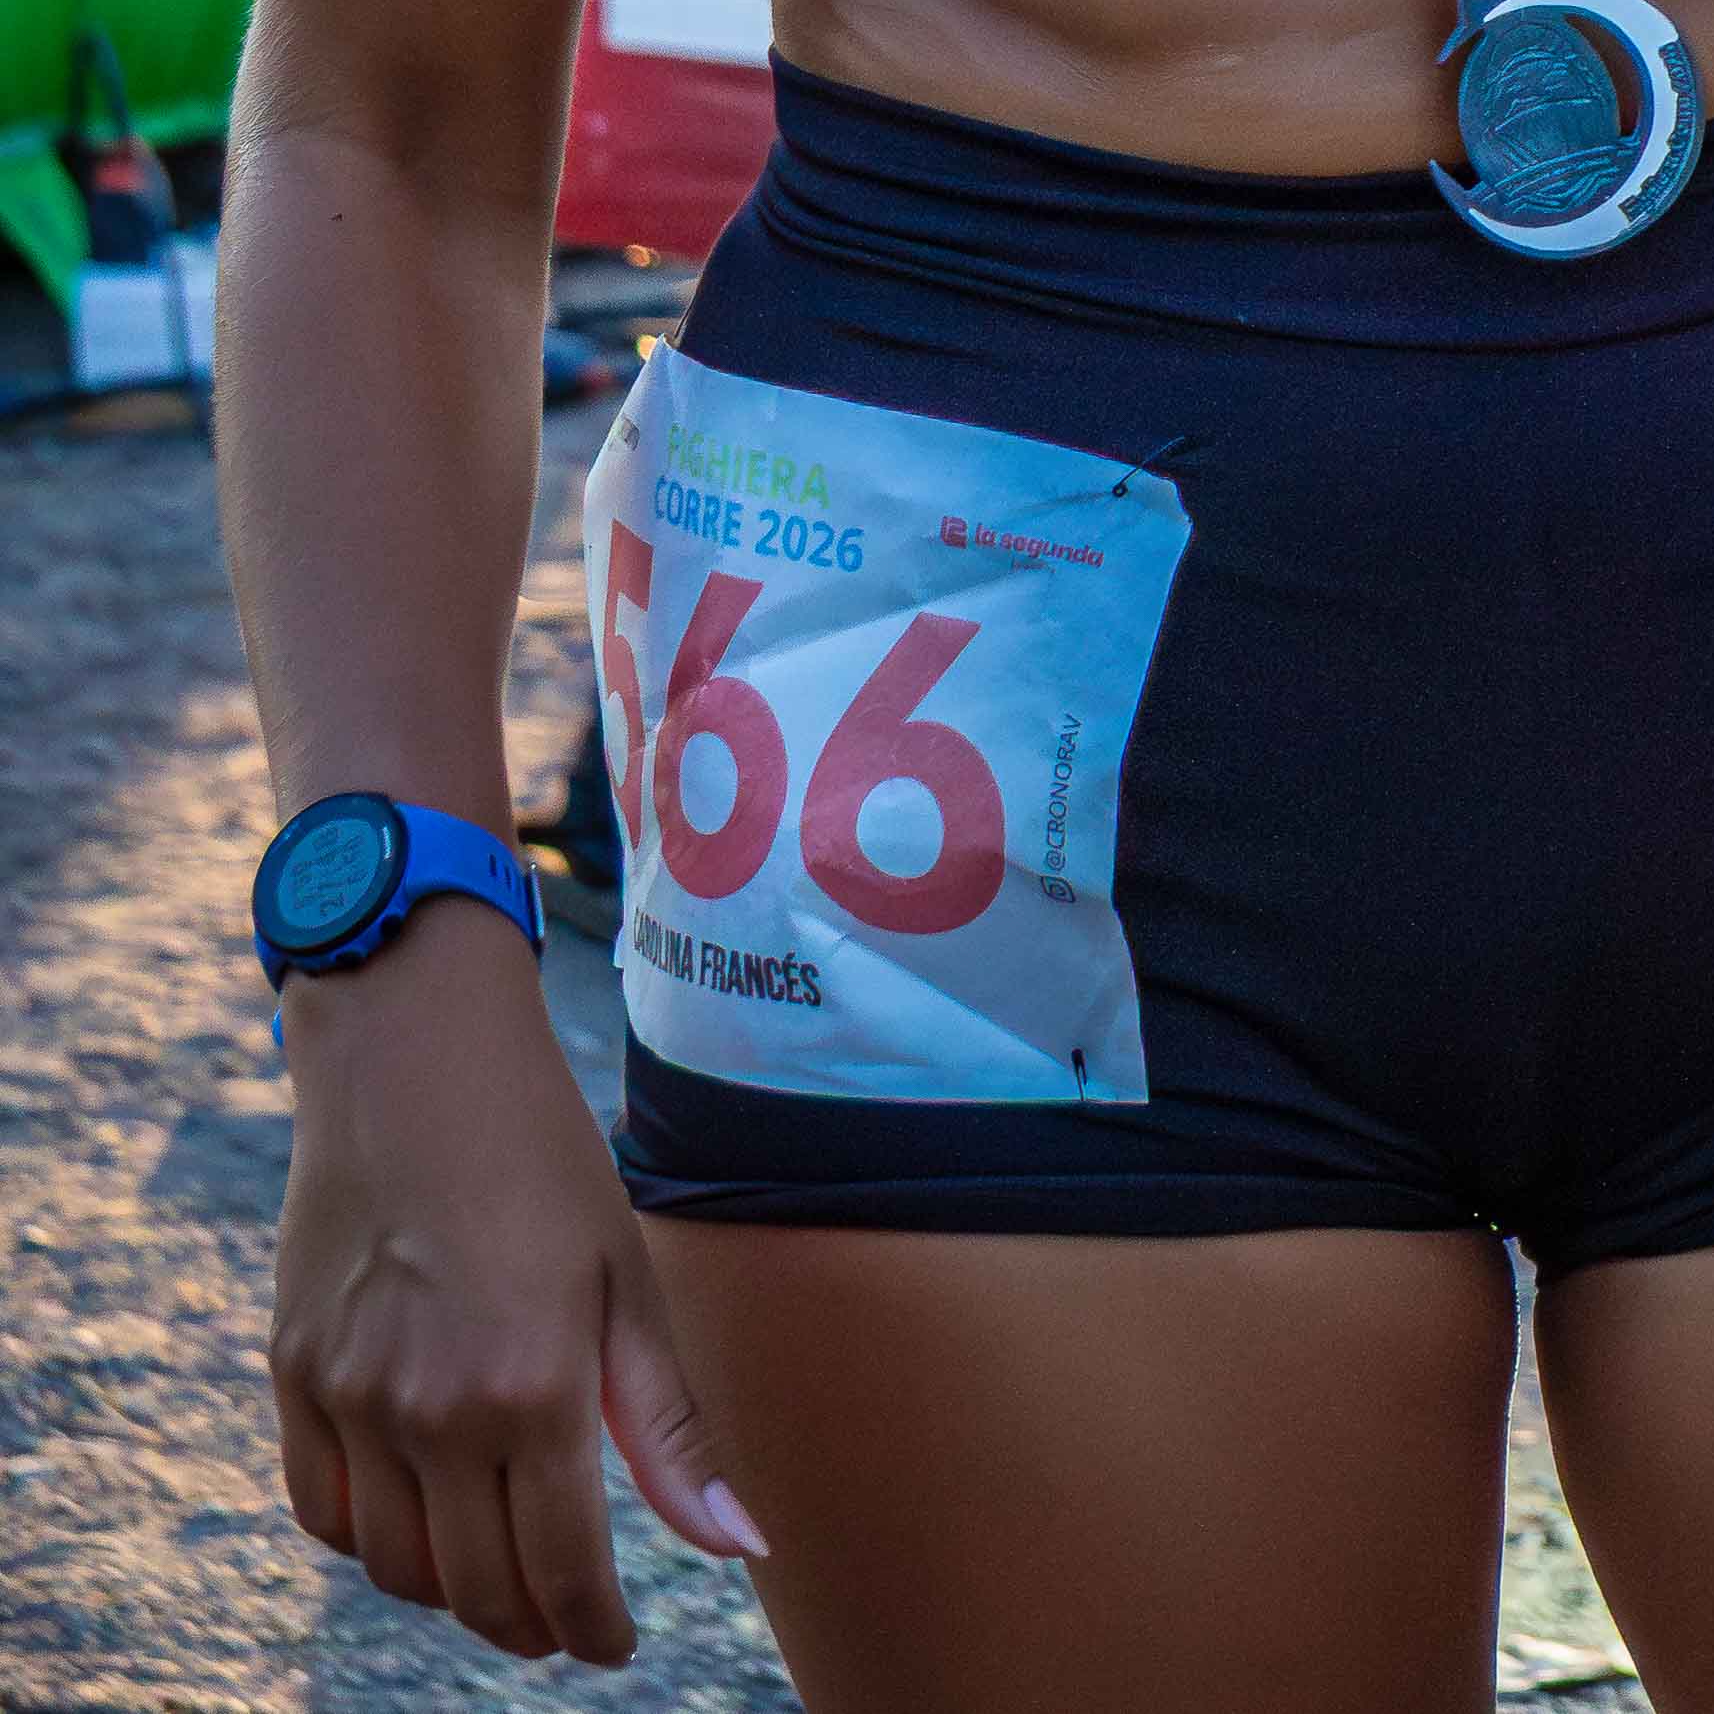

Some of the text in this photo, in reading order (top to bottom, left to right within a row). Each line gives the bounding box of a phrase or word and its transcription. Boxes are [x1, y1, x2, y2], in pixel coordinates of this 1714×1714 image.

[655, 474, 865, 572] CORRE 2026
[974, 522, 996, 548] la
[1000, 532, 1105, 568] segunda
[602, 518, 1006, 935] 566
[1047, 713, 1083, 872] @CRONORAV
[698, 947, 822, 1007] FRANCÉS
